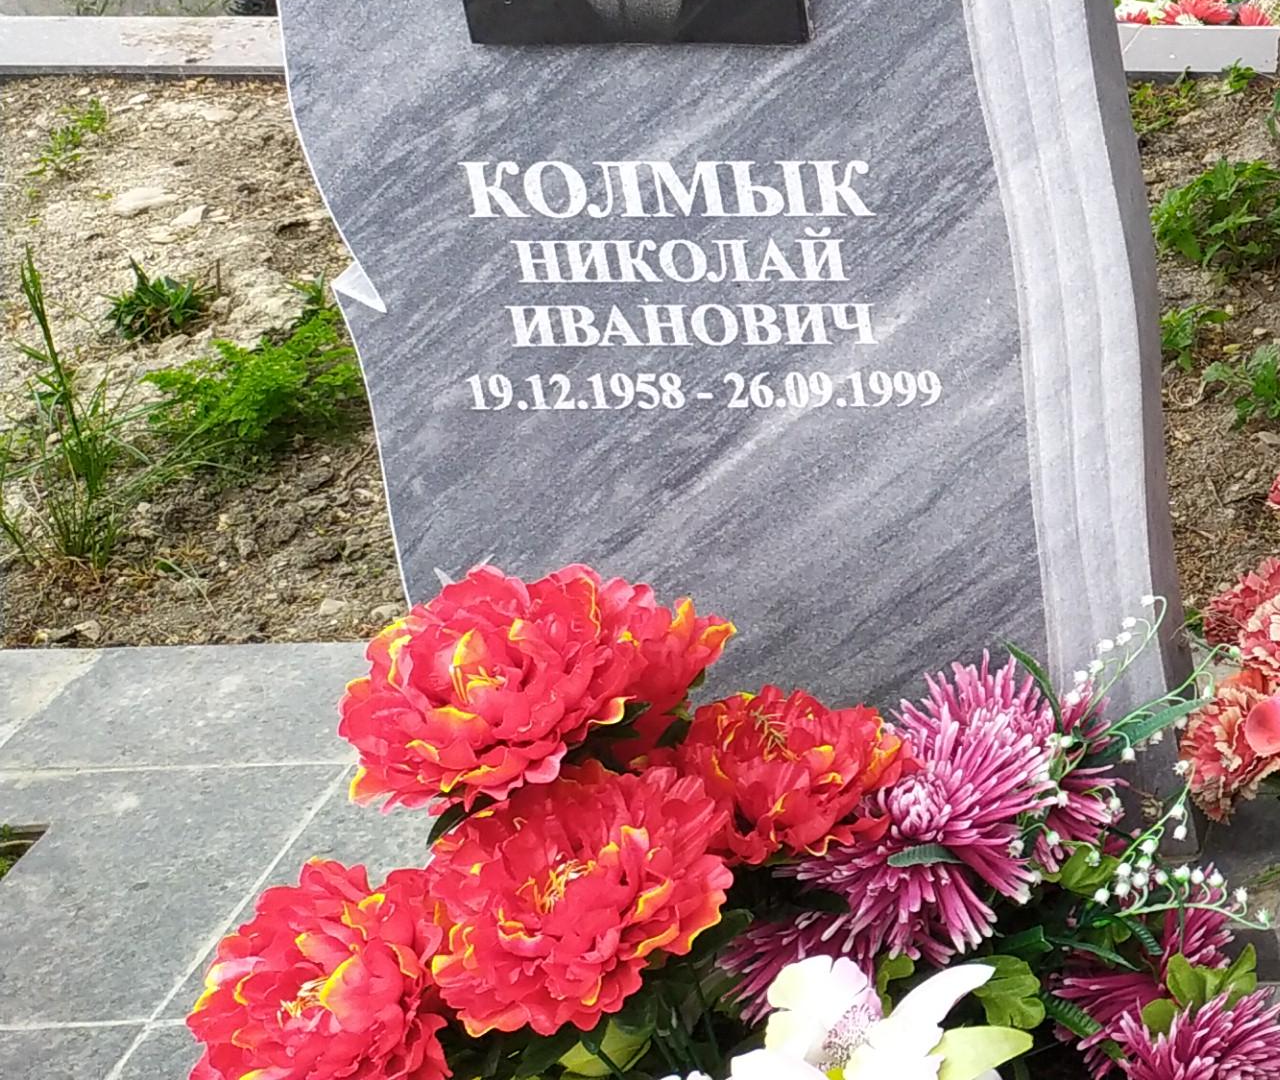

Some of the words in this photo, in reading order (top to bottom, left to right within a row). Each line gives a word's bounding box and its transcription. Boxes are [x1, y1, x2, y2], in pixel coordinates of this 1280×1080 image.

[458, 159, 876, 219] КОЛМЫК
[510, 227, 850, 284] НИКОЛАЙ
[504, 302, 879, 348] ИВАНОВИЧ
[465, 373, 686, 411] 19.12.1958
[725, 370, 942, 409] 26.09.1999
